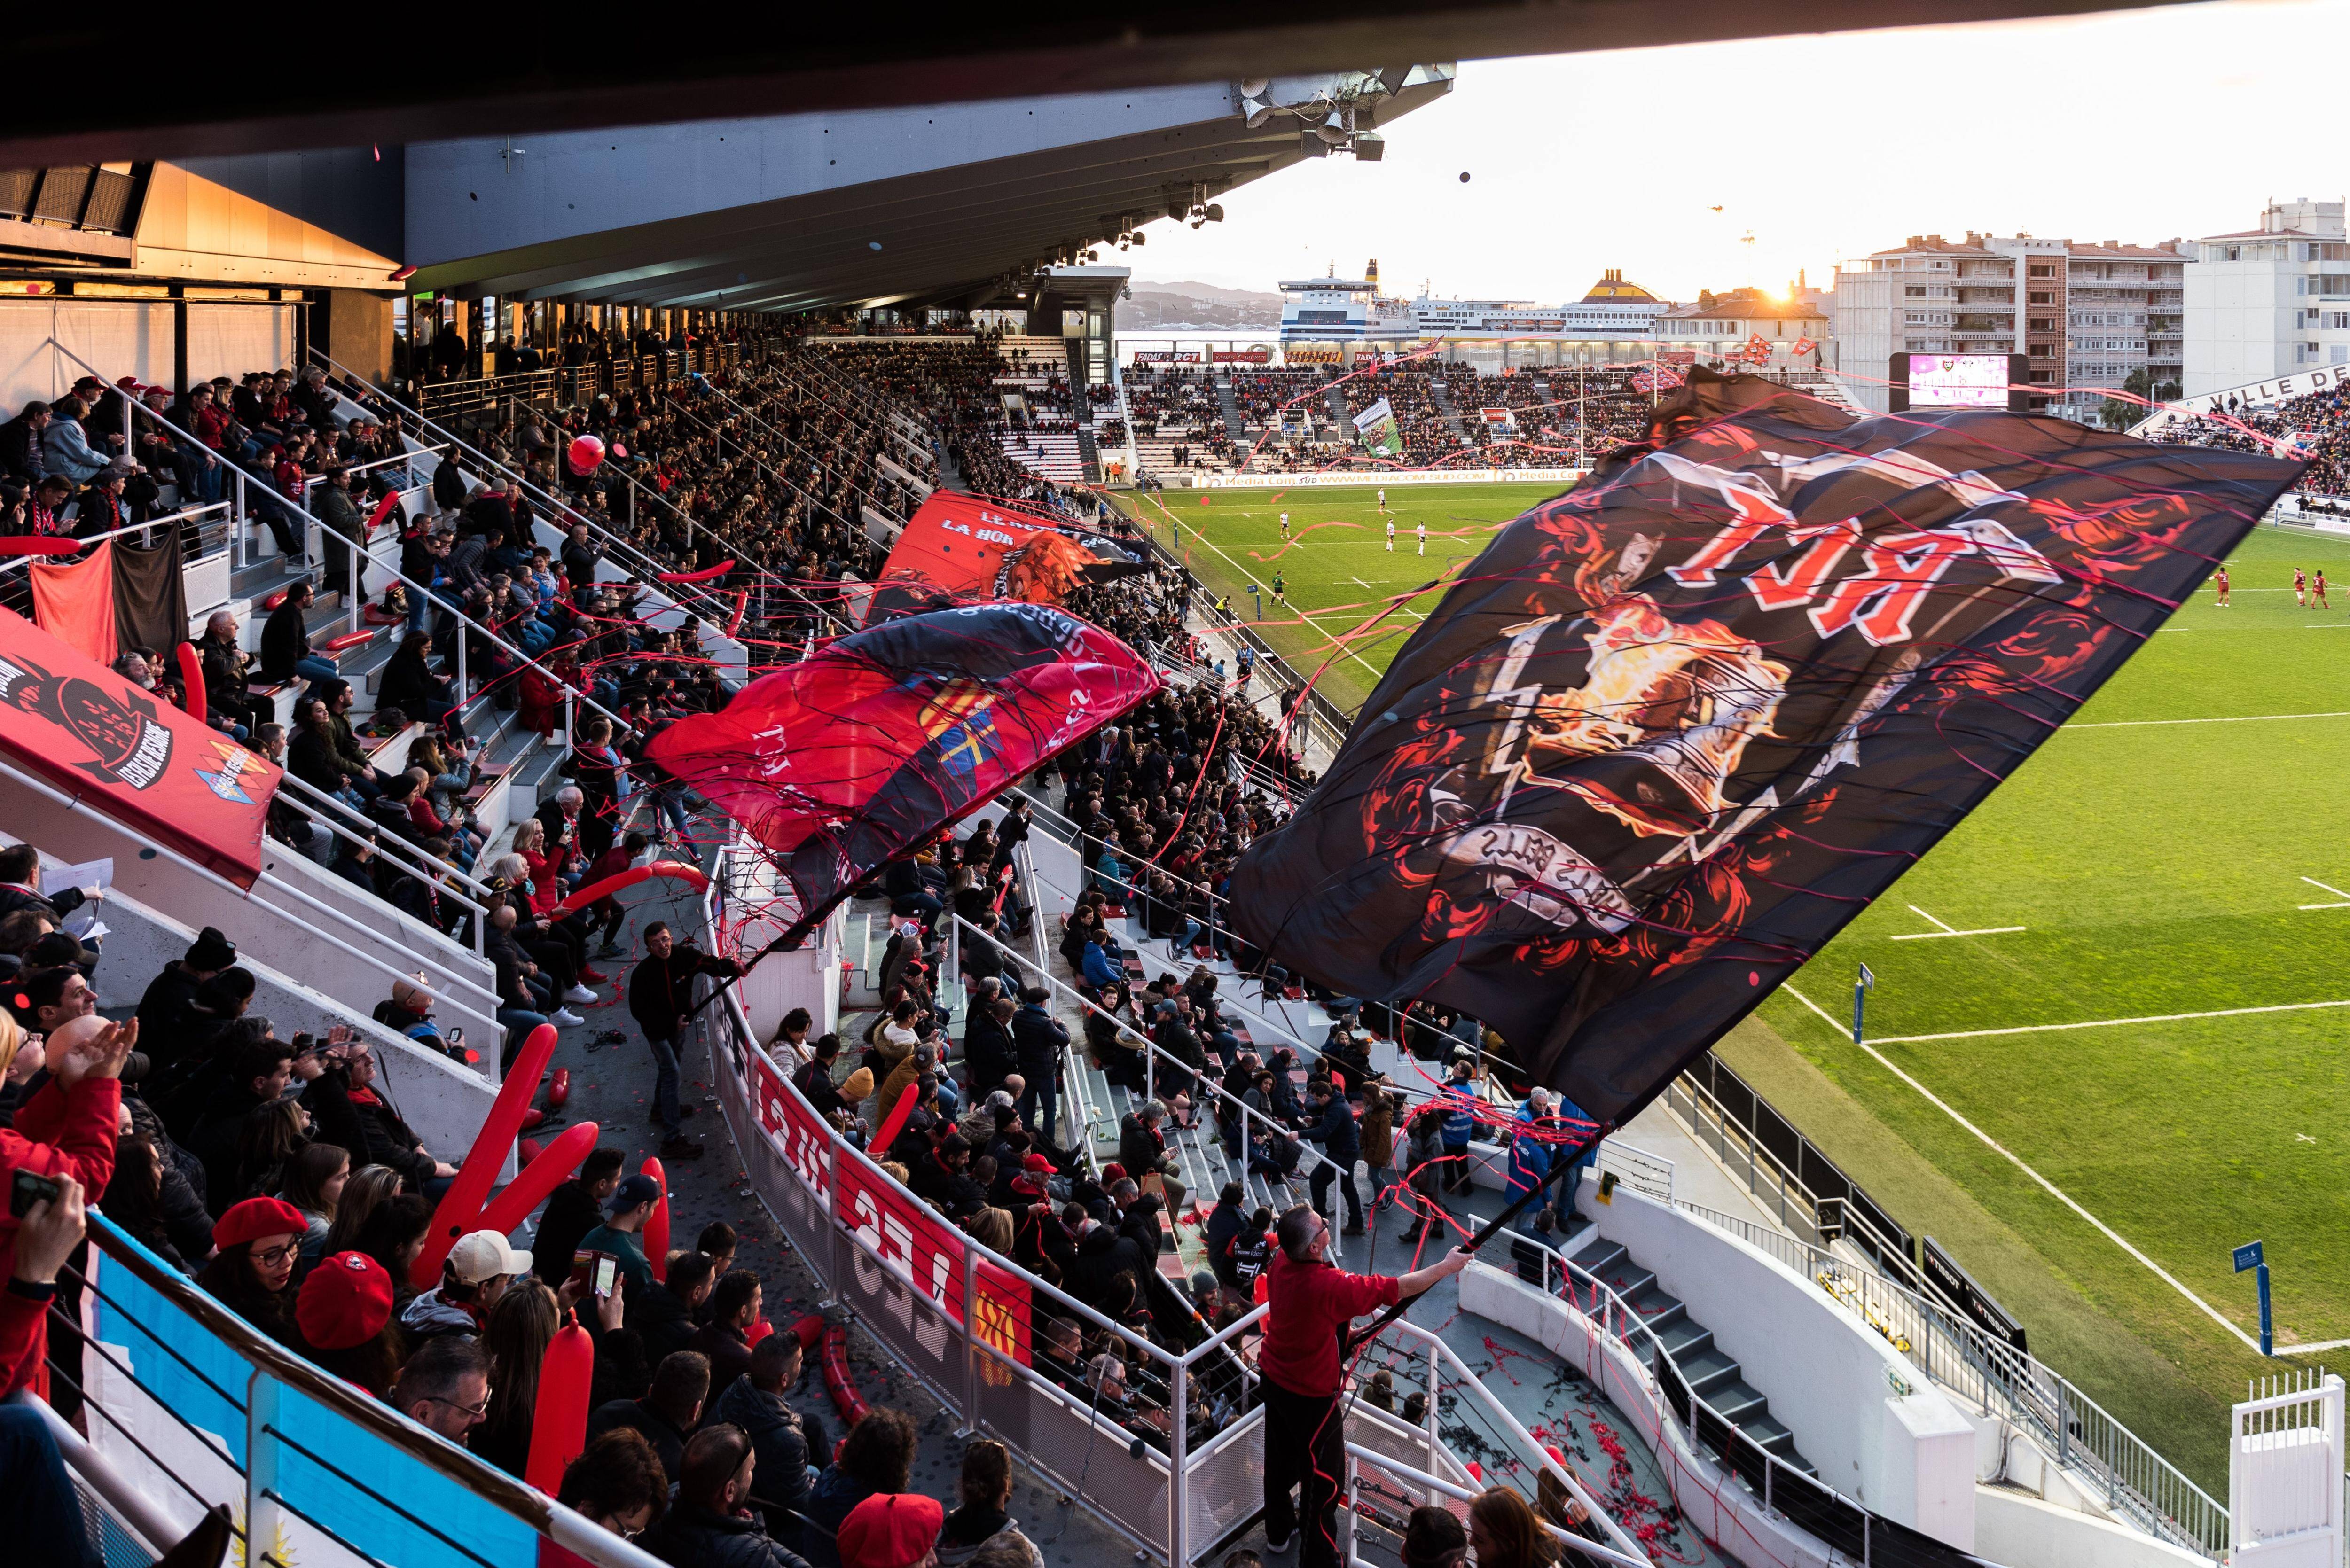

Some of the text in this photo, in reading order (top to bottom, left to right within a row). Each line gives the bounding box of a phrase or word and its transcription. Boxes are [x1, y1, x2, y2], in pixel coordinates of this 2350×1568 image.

[1137, 353, 1199, 361] FADAS RCT
[1226, 476, 1264, 485] Media
[1520, 470, 1556, 479] Media
[941, 519, 971, 535] LA
[117, 769, 147, 788] LES
[141, 721, 169, 760] BESAGNE
[1934, 1258, 1959, 1289] TISSOT
[1982, 1307, 2011, 1342] TISSOT
